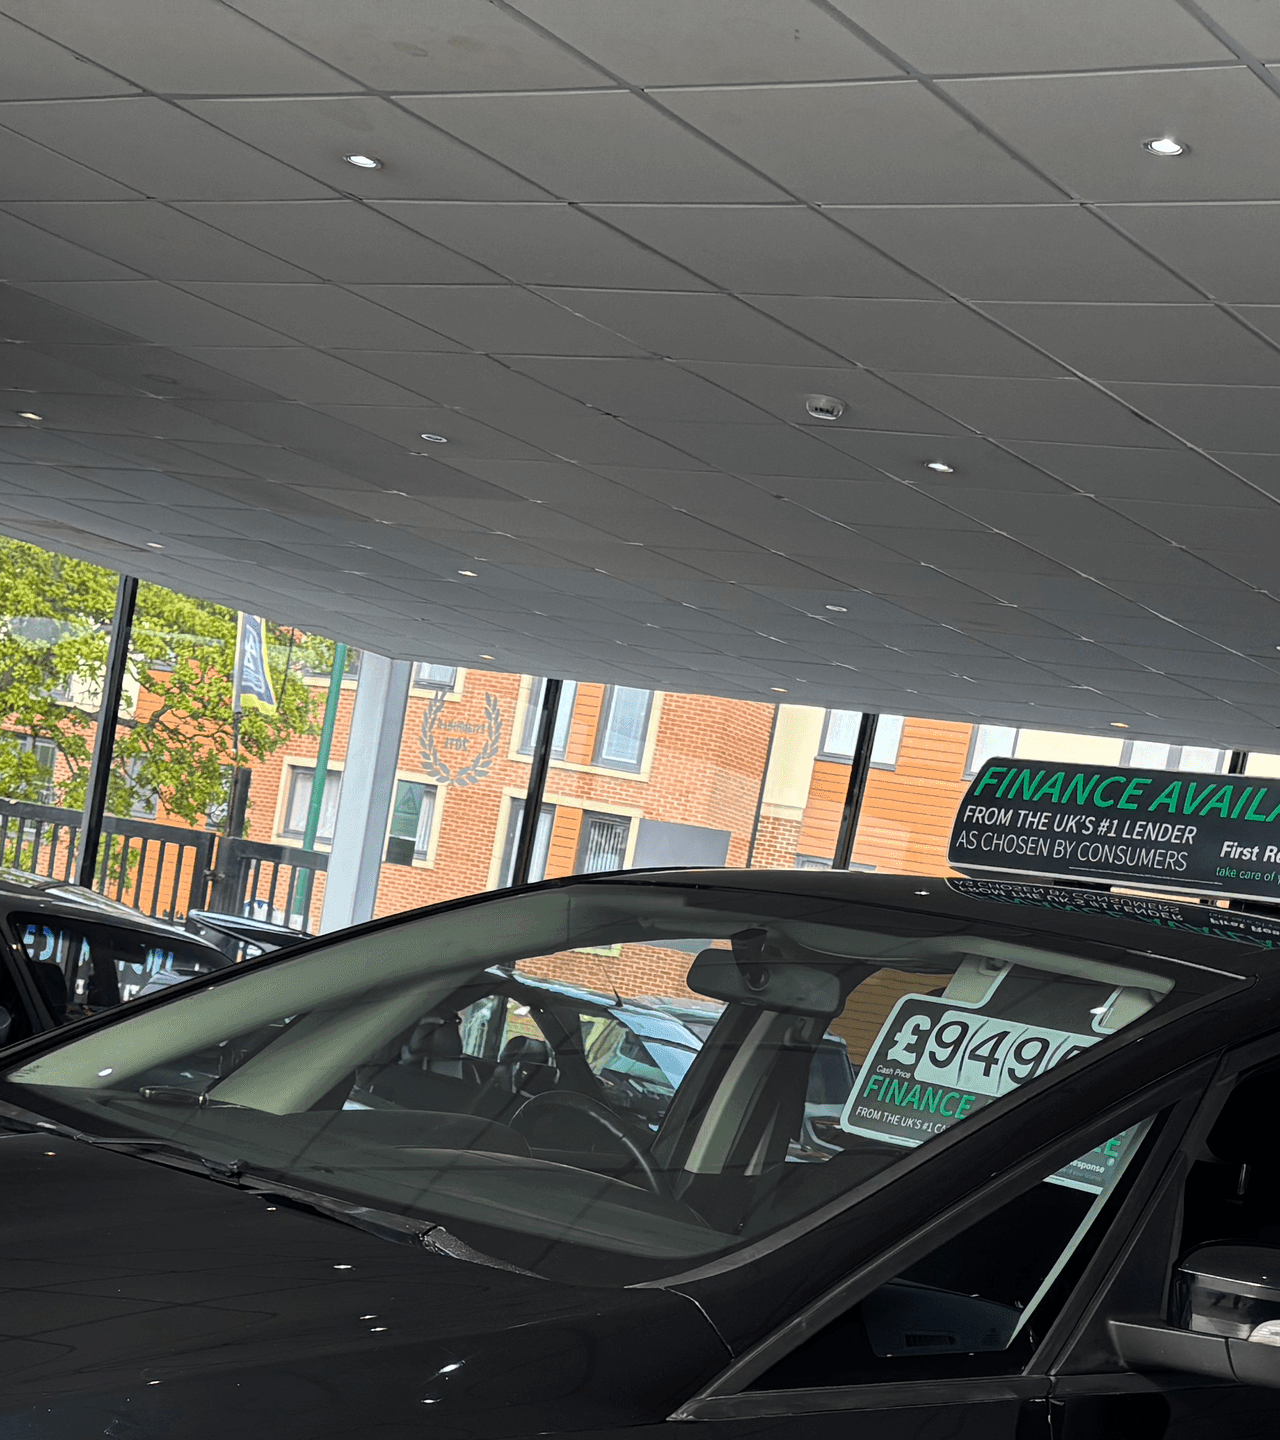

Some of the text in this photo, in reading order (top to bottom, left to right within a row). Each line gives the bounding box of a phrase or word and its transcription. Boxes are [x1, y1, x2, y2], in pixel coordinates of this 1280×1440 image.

[974, 766, 1152, 810] FINANCE
[963, 805, 1197, 845] FROM THE UK'S #1 LENDER
[956, 830, 1188, 872] AS CHOSEN BY CONSUMERS
[1220, 841, 1258, 861] First
[1216, 867, 1236, 878] take
[1239, 870, 1261, 880] care
[1264, 871, 1276, 882] of
[876, 1064, 912, 1080] Cash Price
[863, 1075, 976, 1119] FINANCE
[856, 1106, 950, 1134] FROM THE UK'S #1 CA
[1070, 1160, 1105, 1173] esponse
